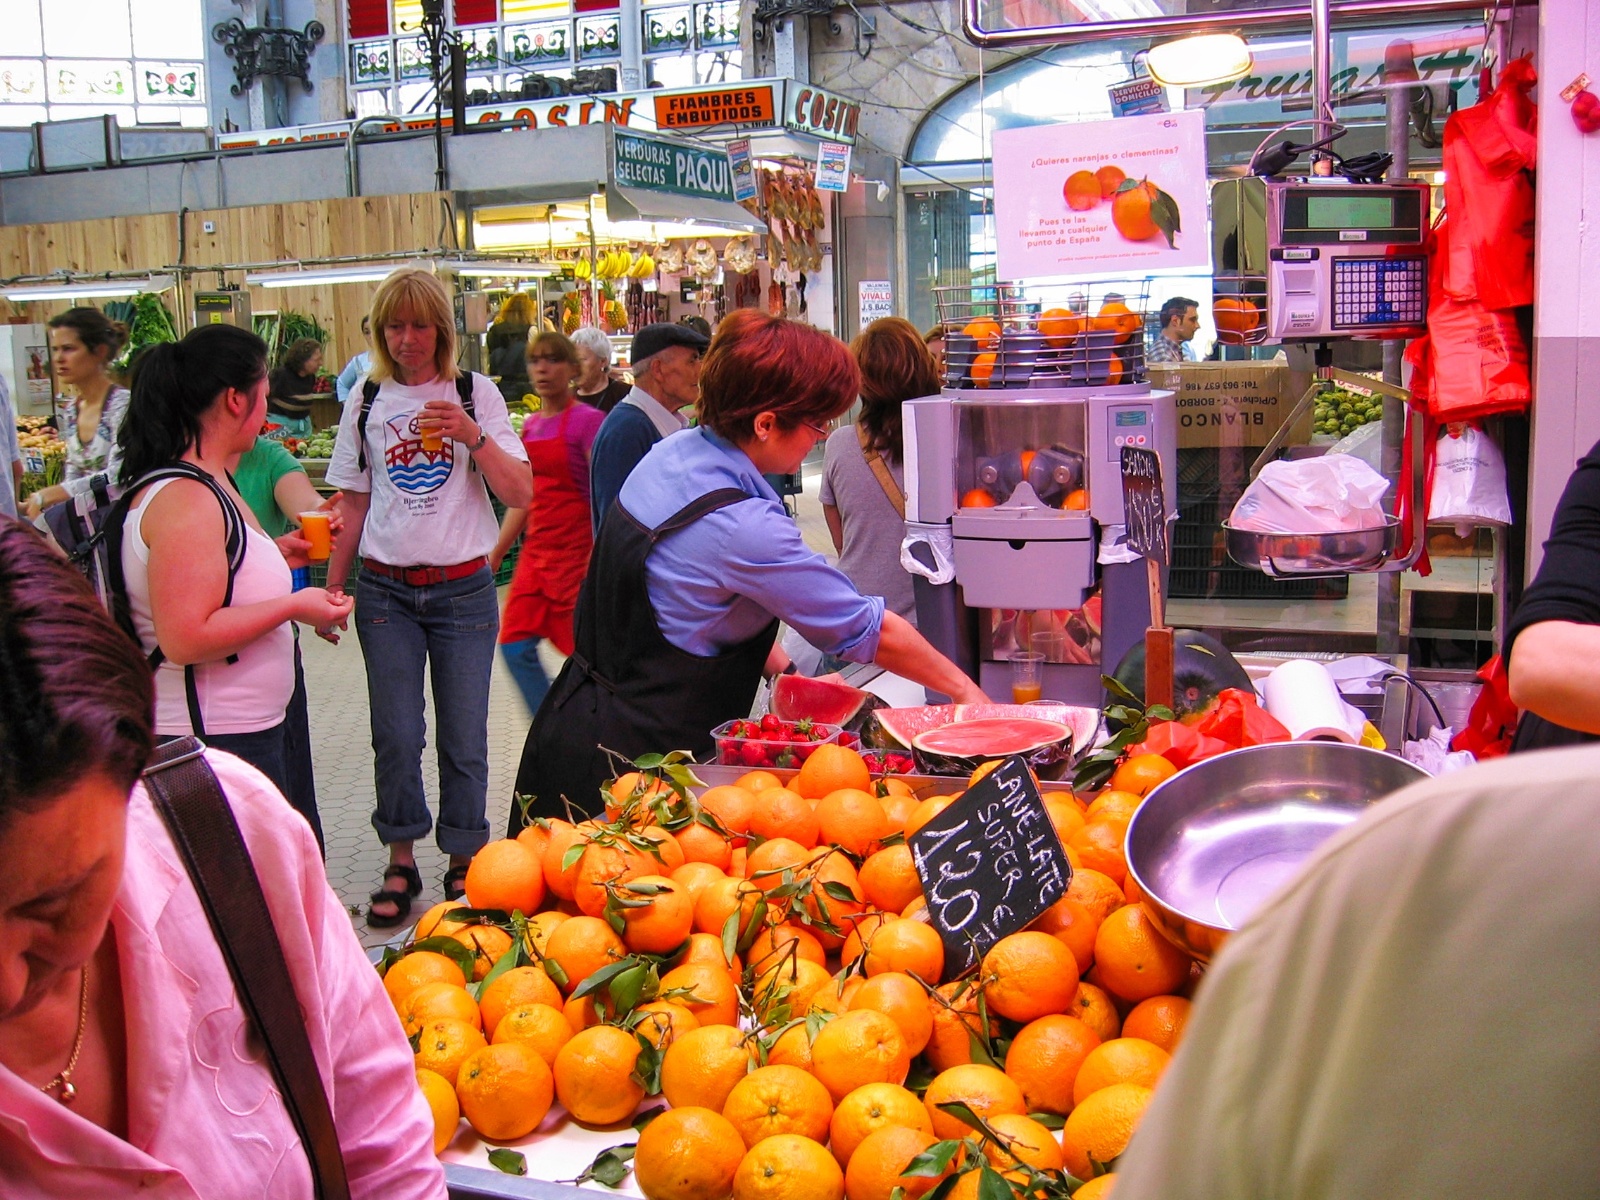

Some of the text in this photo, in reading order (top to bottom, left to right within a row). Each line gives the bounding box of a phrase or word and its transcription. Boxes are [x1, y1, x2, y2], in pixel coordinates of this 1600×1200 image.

[1113, 83, 1150, 97] SERVICIO
[1115, 87, 1160, 104] DOMICILIO
[669, 91, 756, 111] FIAMBRES
[666, 105, 762, 125] EMBUTIDOS
[795, 89, 860, 138] COSIN
[616, 138, 671, 166] VERDURAS
[1031, 158, 1070, 168] ¿Quieres
[1072, 153, 1109, 163] naranjas
[1121, 146, 1179, 159] clementinas?
[618, 161, 666, 185] SELECTAS
[675, 152, 729, 194] PAQUI
[1039, 216, 1087, 226] Pues te las
[1019, 228, 1057, 238] llevamos
[1067, 225, 1108, 236] cualquier
[1027, 239, 1053, 248] punto
[1069, 235, 1100, 246] España
[1185, 380, 1258, 391] Tel: 963 637 186
[1180, 412, 1264, 428] BLANCO
[977, 802, 1024, 901] SUPER
